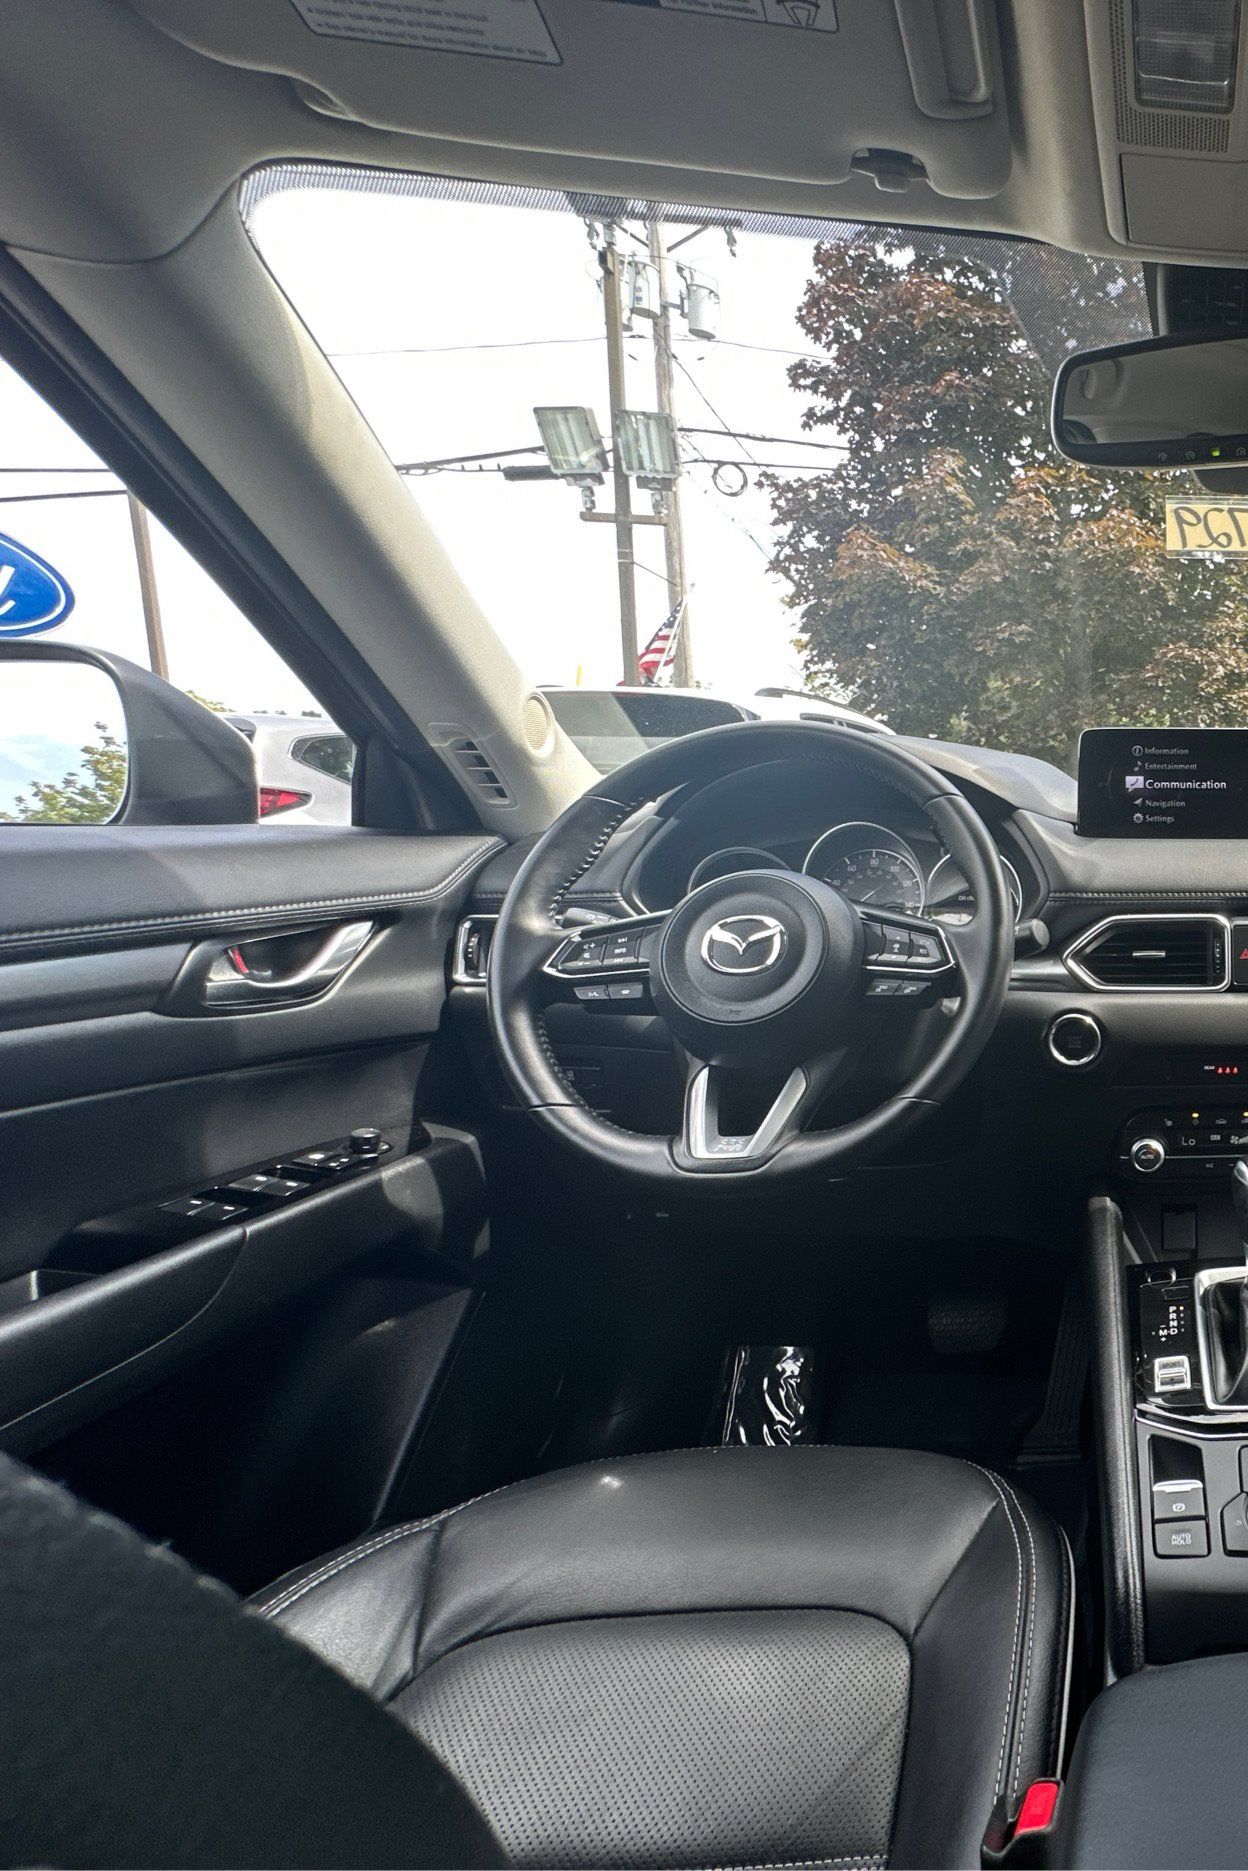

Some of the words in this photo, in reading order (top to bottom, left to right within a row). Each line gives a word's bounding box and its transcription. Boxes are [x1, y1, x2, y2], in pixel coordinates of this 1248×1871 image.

[1145, 746, 1189, 755] Information
[1145, 762, 1197, 771] Entertainment
[1146, 779, 1227, 790] Communication
[1145, 799, 1186, 808] Navigation
[1145, 814, 1175, 824] Settings
[1182, 1136, 1196, 1146] Lo
[1169, 1305, 1178, 1313] P
[1169, 1312, 1177, 1320] R
[1169, 1319, 1178, 1328] N
[1159, 1328, 1168, 1337] M
[1170, 1327, 1179, 1335] D
[1171, 1538, 1192, 1546] HOLD
